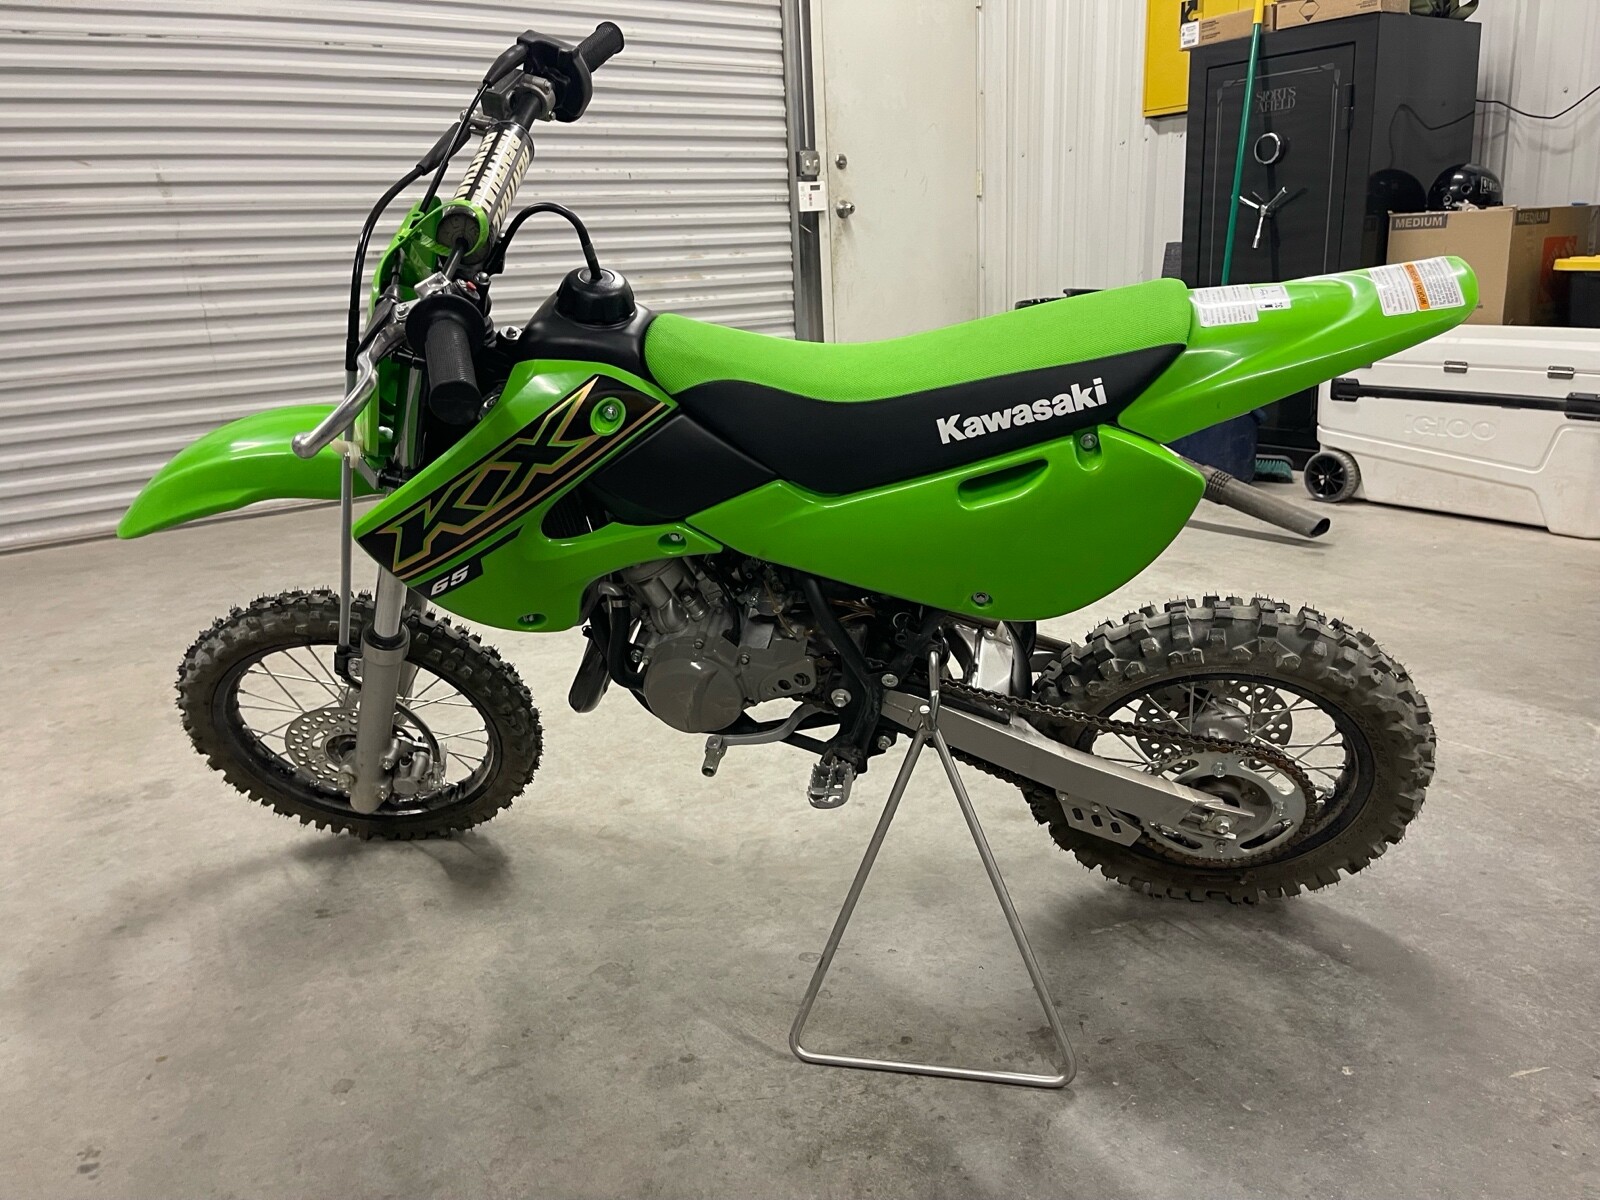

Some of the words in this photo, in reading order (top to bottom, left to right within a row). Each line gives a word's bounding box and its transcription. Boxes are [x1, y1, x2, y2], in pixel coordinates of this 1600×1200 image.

[1395, 216, 1443, 228] MEDIUM
[1518, 210, 1549, 224] MEDIUM
[936, 377, 1108, 444] Kawasaki
[1403, 413, 1497, 441] IGLOO
[431, 565, 470, 596] 65
